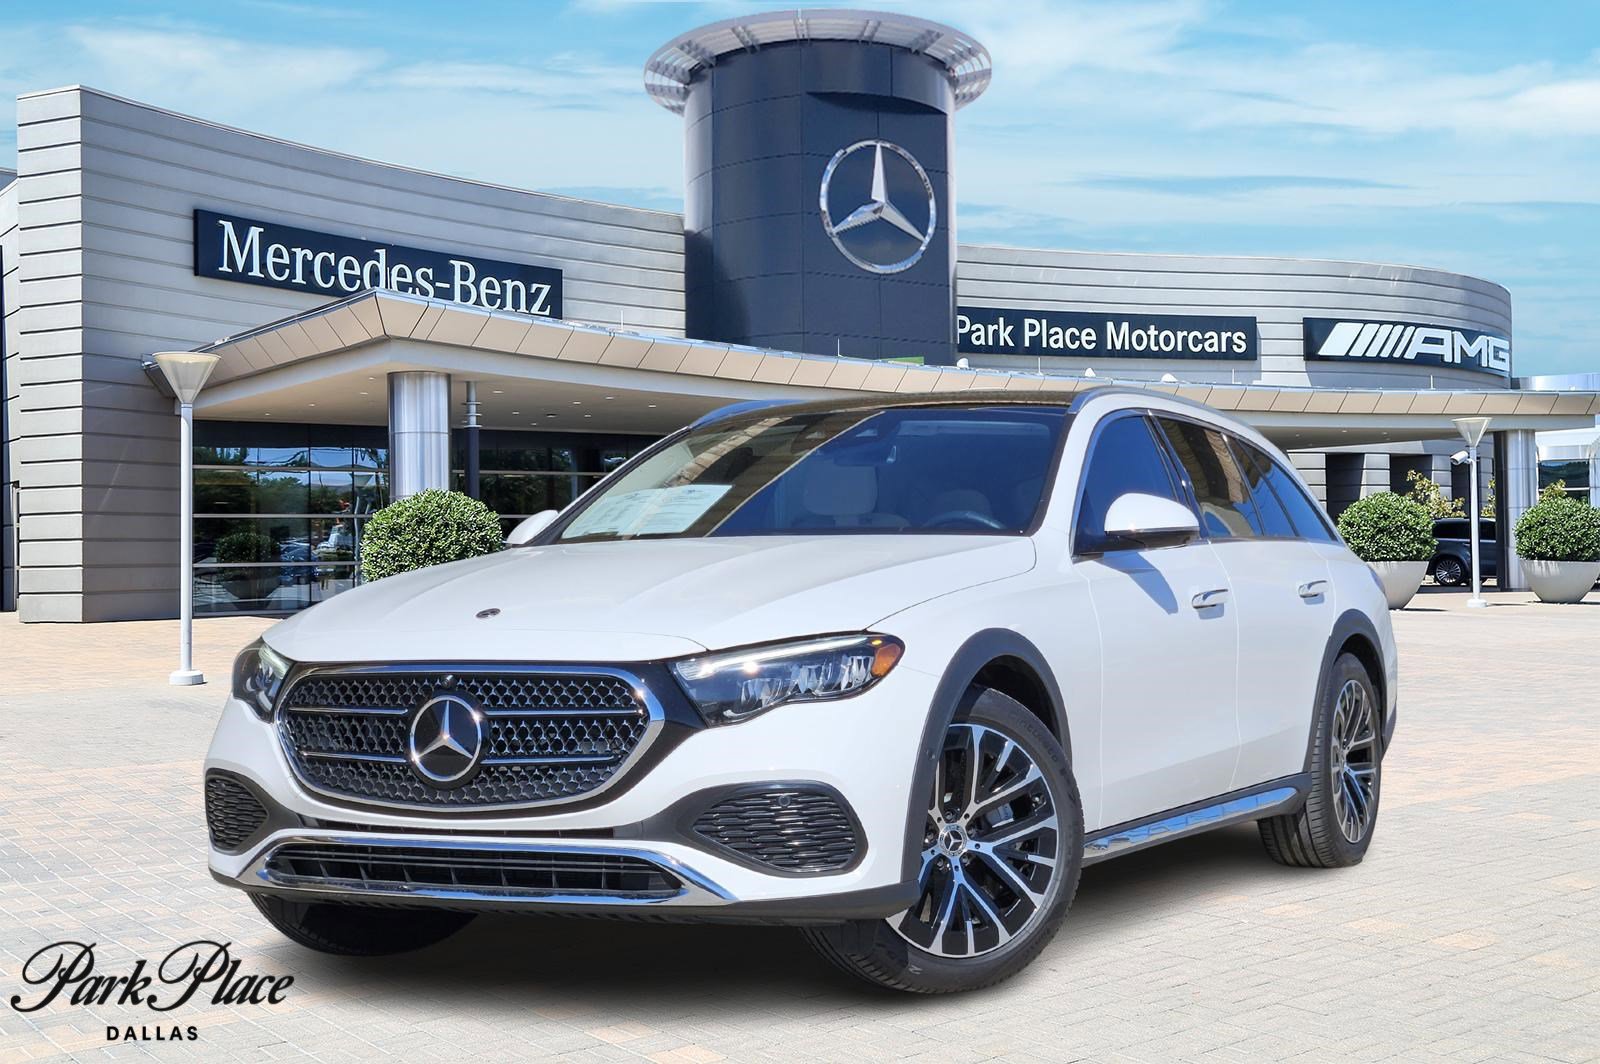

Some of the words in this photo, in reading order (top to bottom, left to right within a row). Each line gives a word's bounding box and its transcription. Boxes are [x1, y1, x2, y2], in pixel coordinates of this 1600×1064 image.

[218, 220, 551, 316] Mercedes-Benz
[957, 315, 1014, 347] Park
[1024, 319, 1096, 349] Place
[1106, 321, 1248, 353] Motorcars
[1403, 327, 1510, 372] AMG
